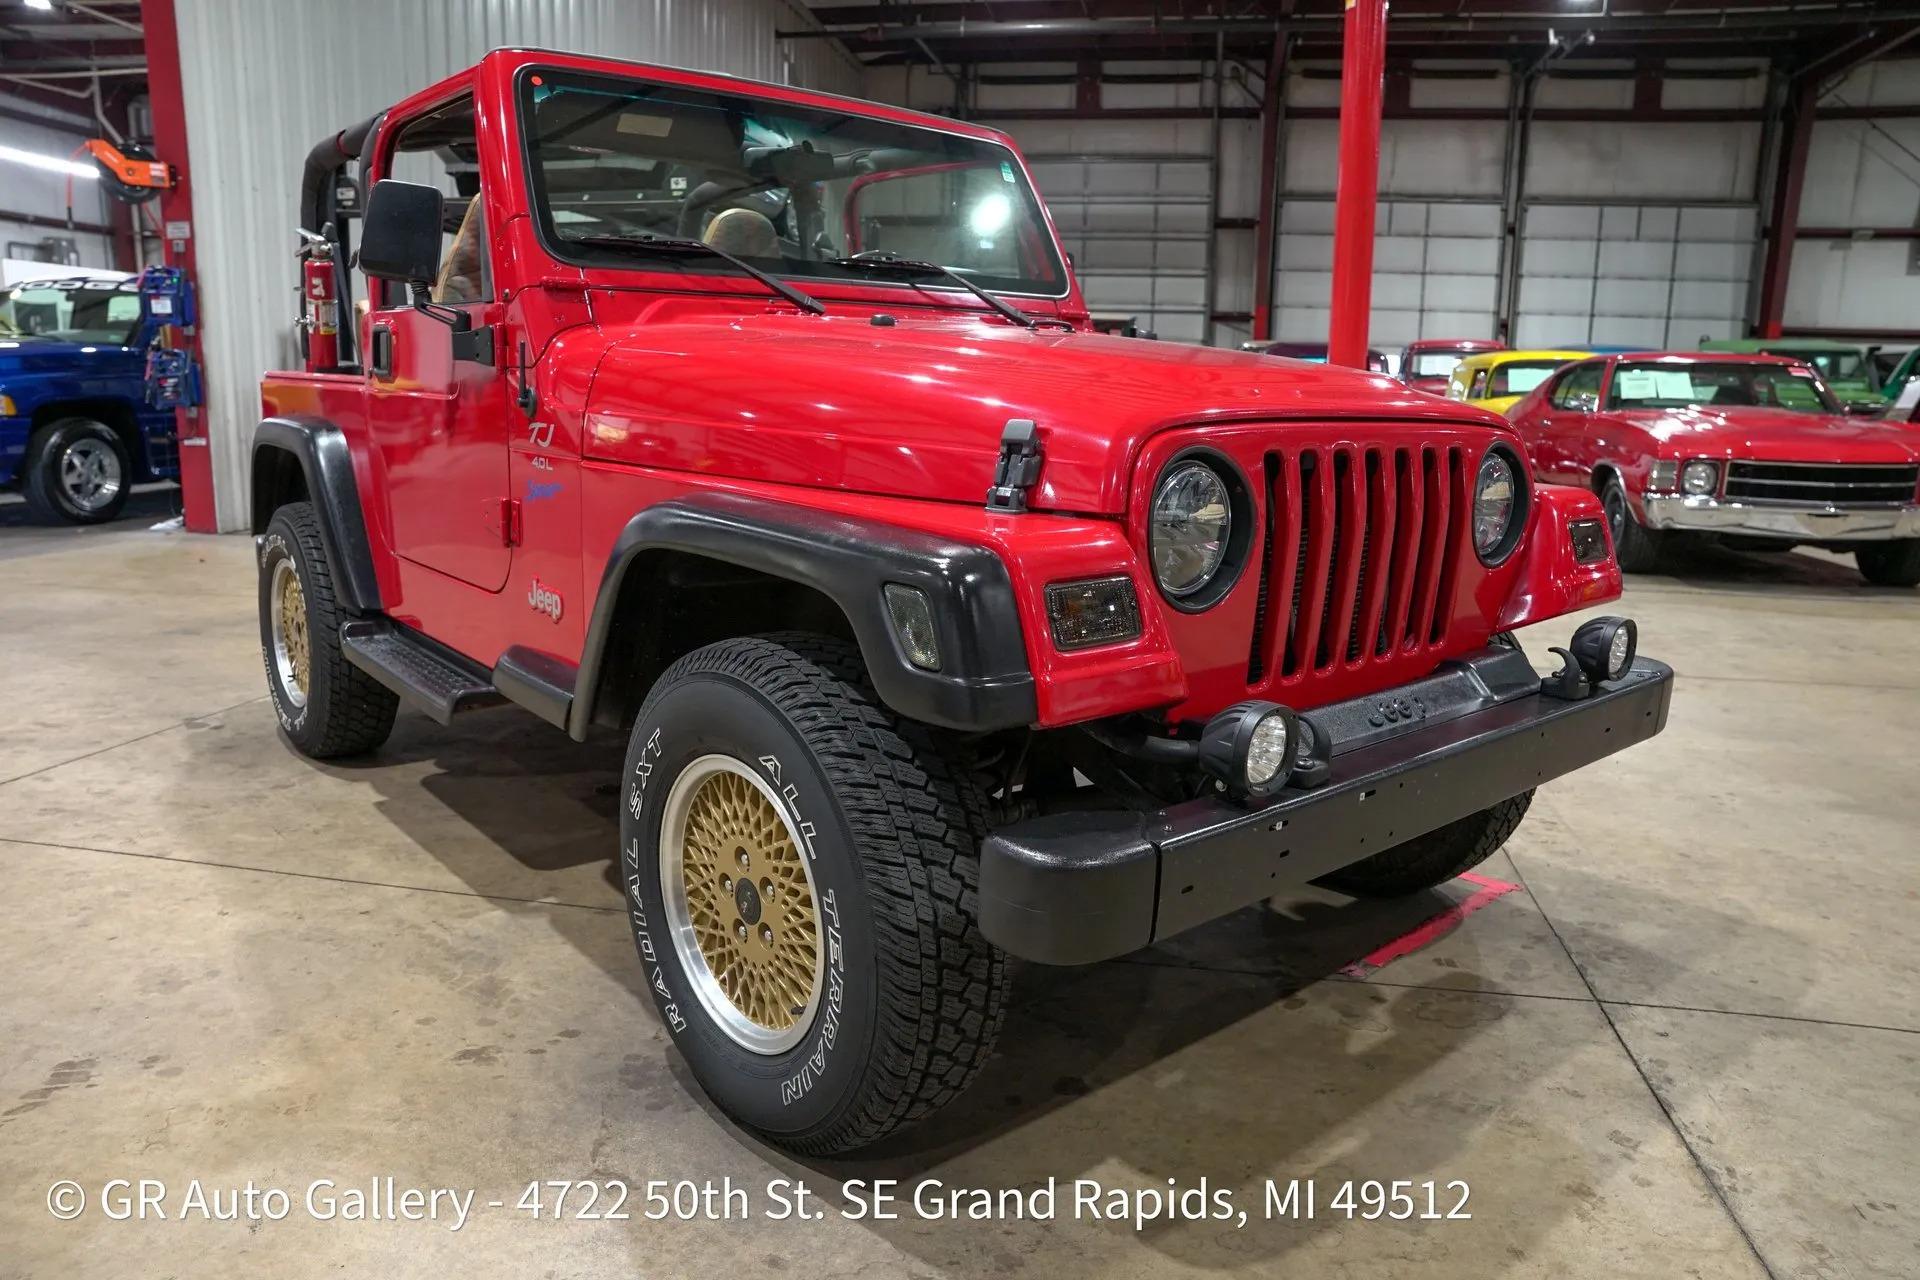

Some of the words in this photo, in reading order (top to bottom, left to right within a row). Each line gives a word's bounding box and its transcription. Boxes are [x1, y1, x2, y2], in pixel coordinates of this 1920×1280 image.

[528, 422, 555, 447] TJ
[528, 579, 561, 620] Jeep
[628, 727, 664, 821] SXT
[758, 753, 819, 861] ALL
[625, 837, 688, 1034] RADIAL
[781, 888, 845, 1107] TERRAIN
